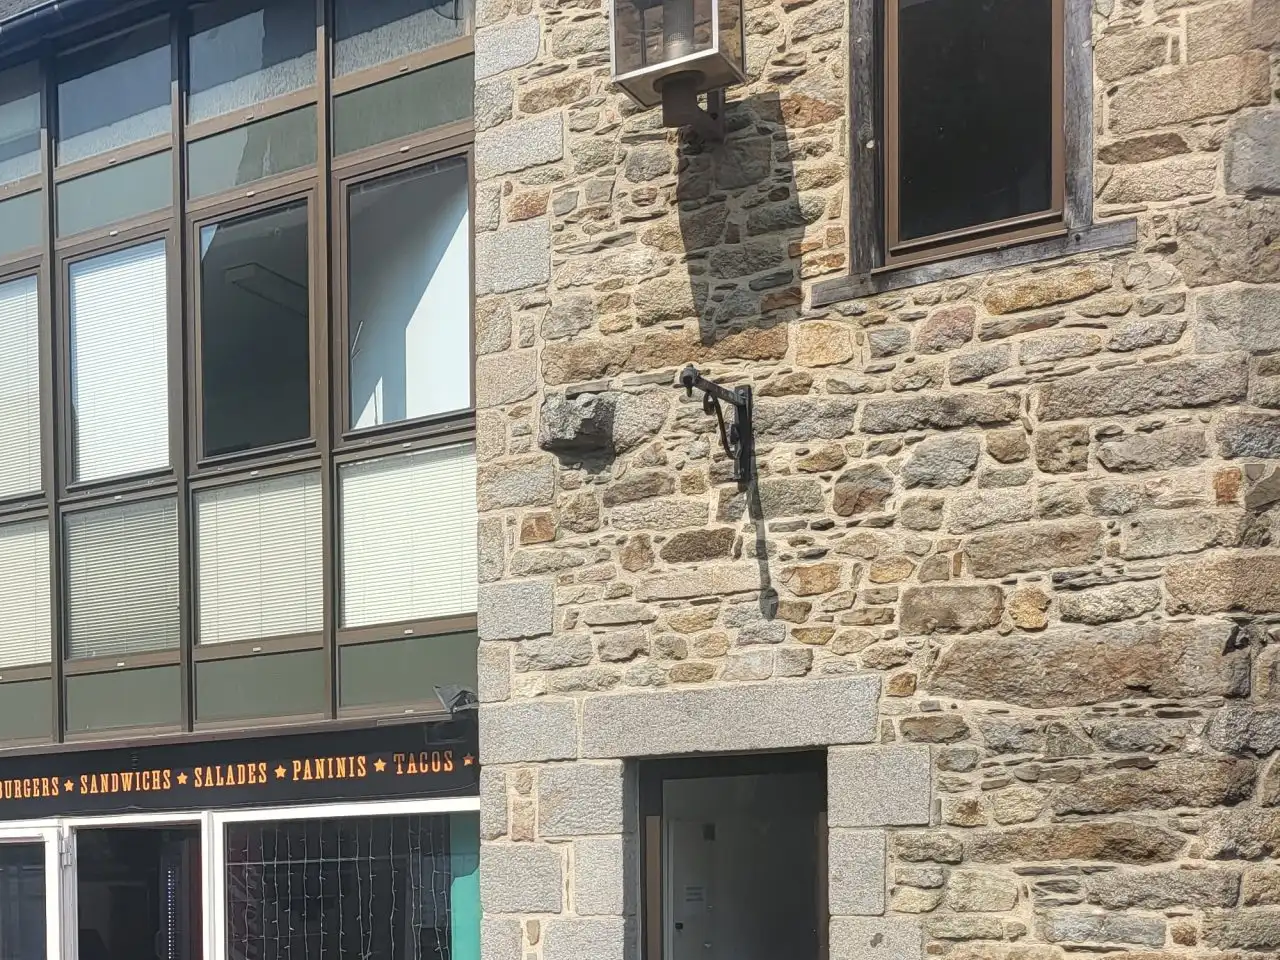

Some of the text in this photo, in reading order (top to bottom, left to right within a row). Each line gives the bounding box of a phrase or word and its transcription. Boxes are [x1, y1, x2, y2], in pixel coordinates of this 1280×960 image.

[80, 769, 171, 795] SANDWICHS
[194, 762, 268, 788] SALADES
[292, 755, 367, 781] PANINIS
[394, 750, 454, 775] TACOS
